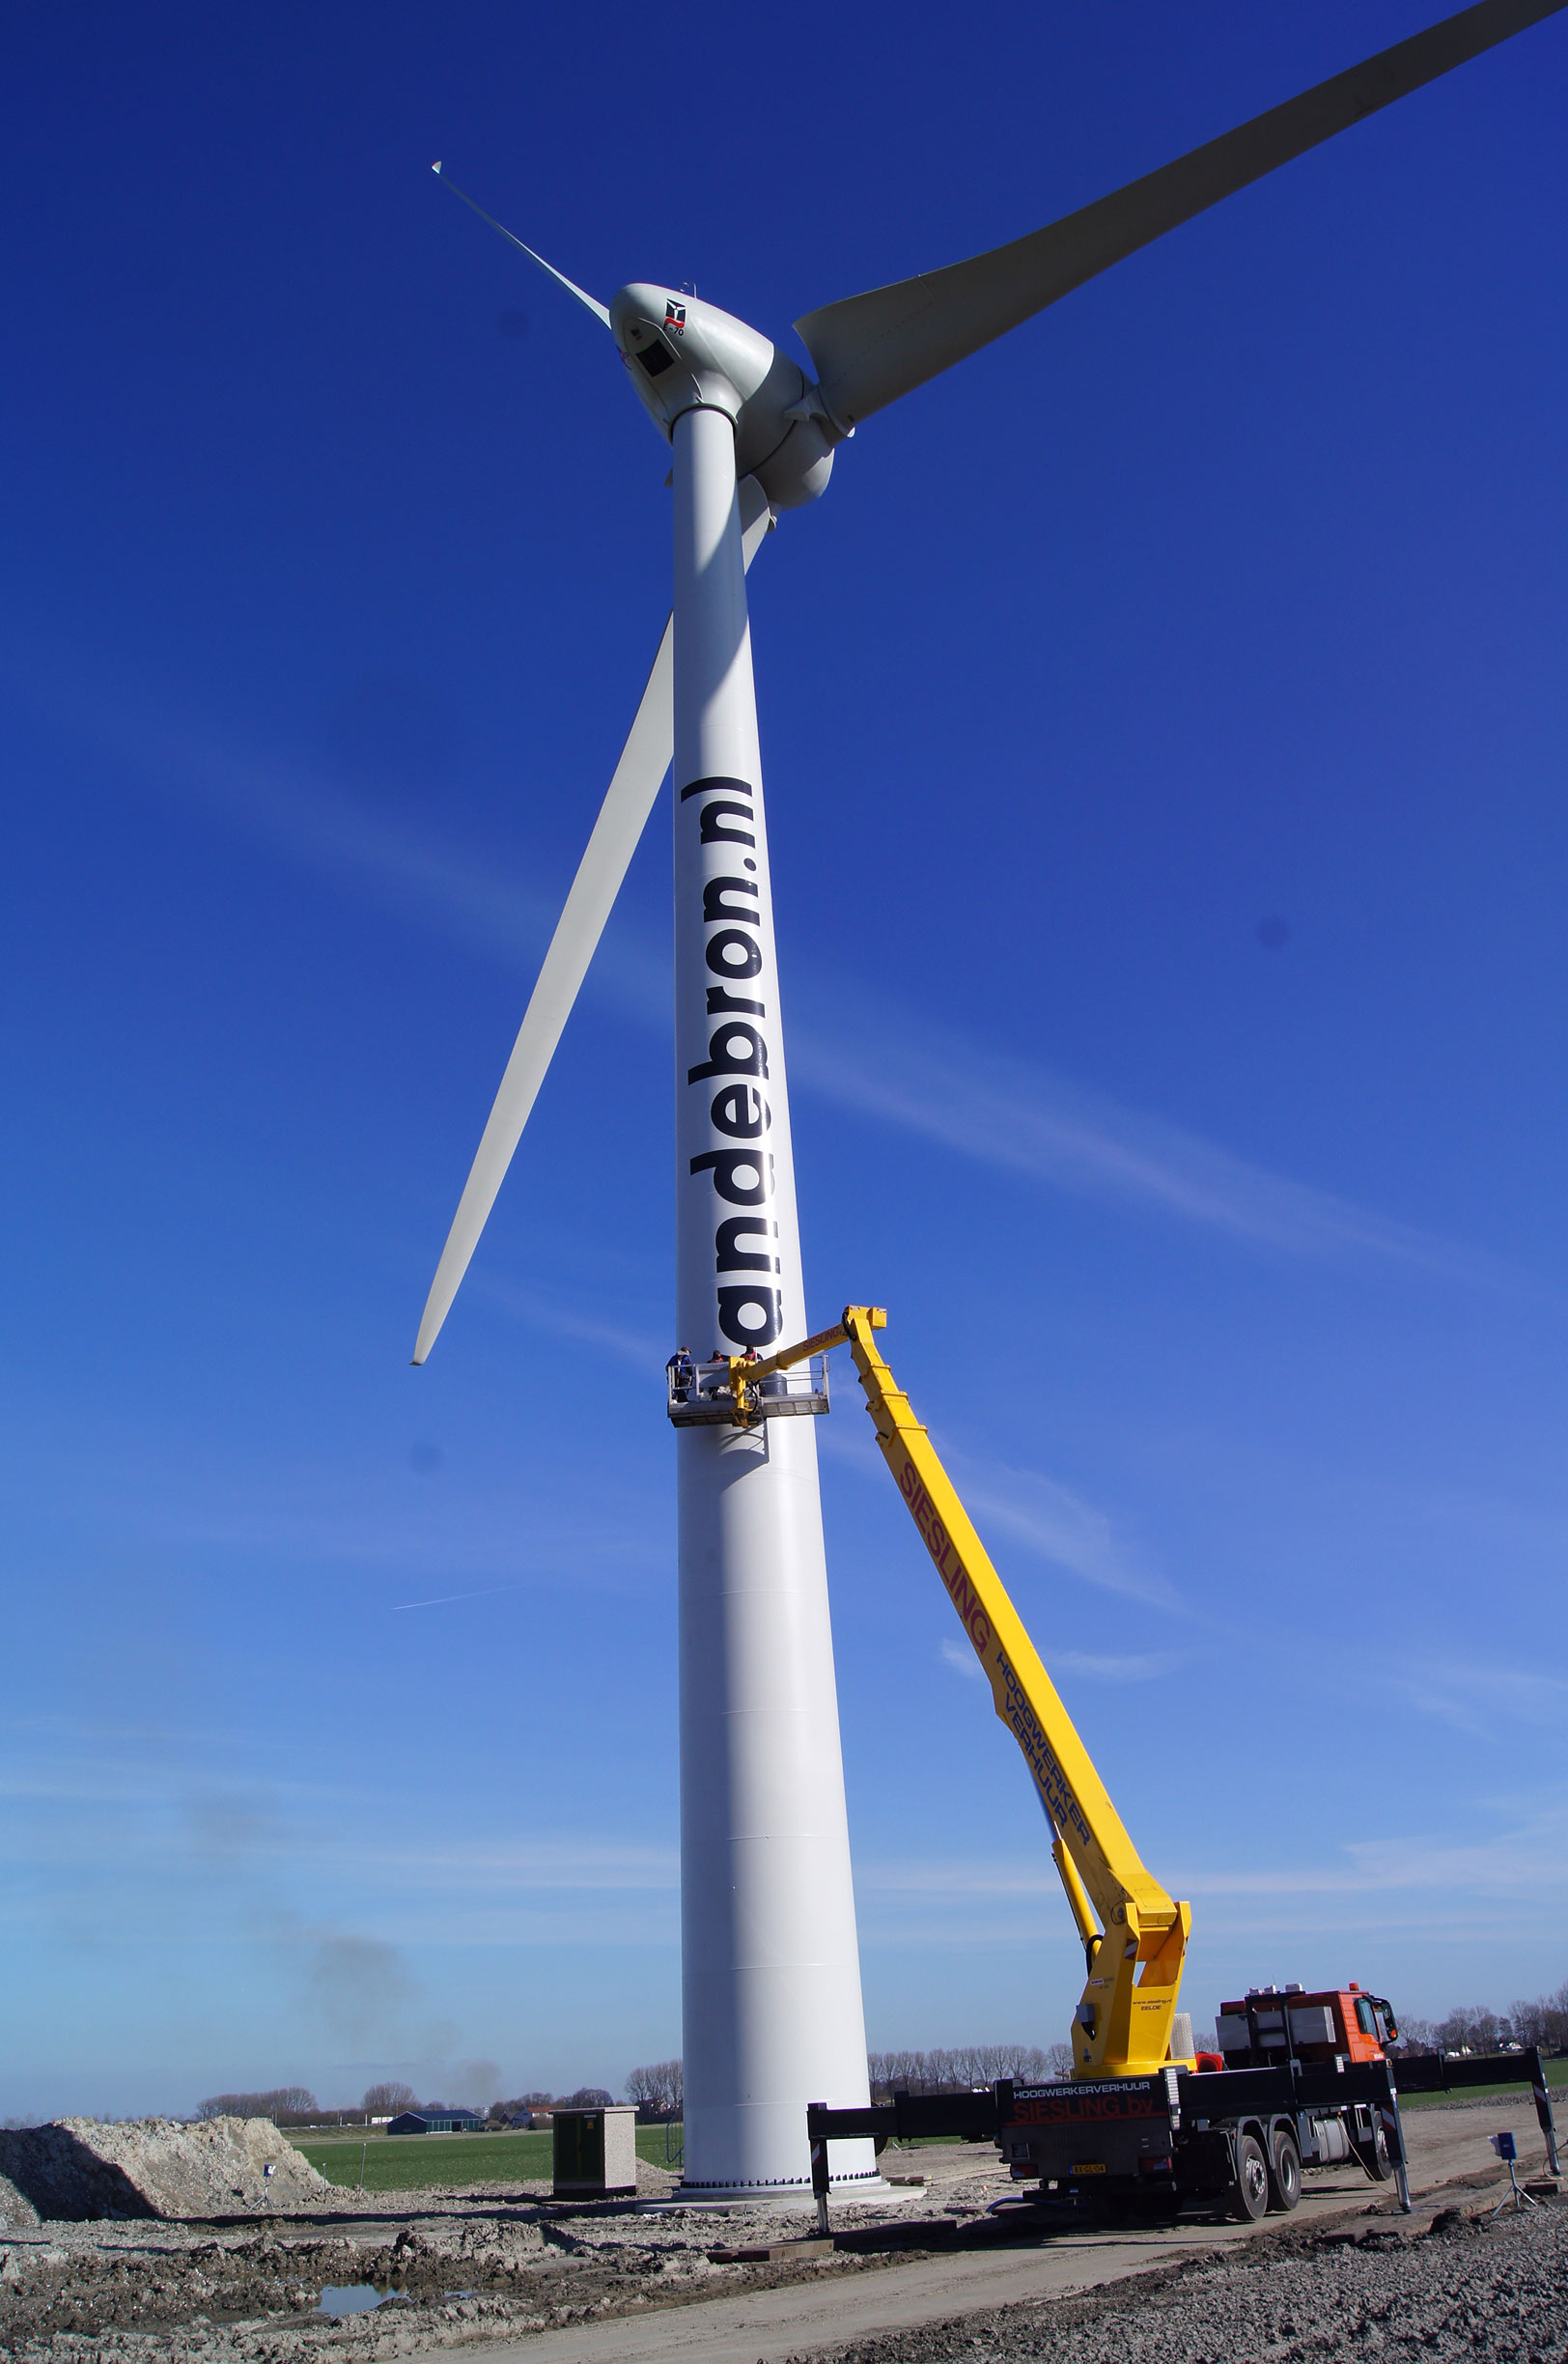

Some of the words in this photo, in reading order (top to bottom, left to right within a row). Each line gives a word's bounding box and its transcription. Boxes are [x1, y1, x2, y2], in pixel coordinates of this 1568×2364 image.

[681, 775, 783, 1347] andebron.nl
[802, 1326, 840, 1352] SIESLING
[900, 1461, 991, 1655] SIESLING
[996, 1651, 1091, 1846] HOOGWERKER
[1005, 1692, 1068, 1827] VERHUUR
[1013, 2096, 1120, 2122] SIESLING
[1127, 2094, 1154, 2114] bv
[1014, 2081, 1151, 2099] HOOGWERKERVERHUUR
